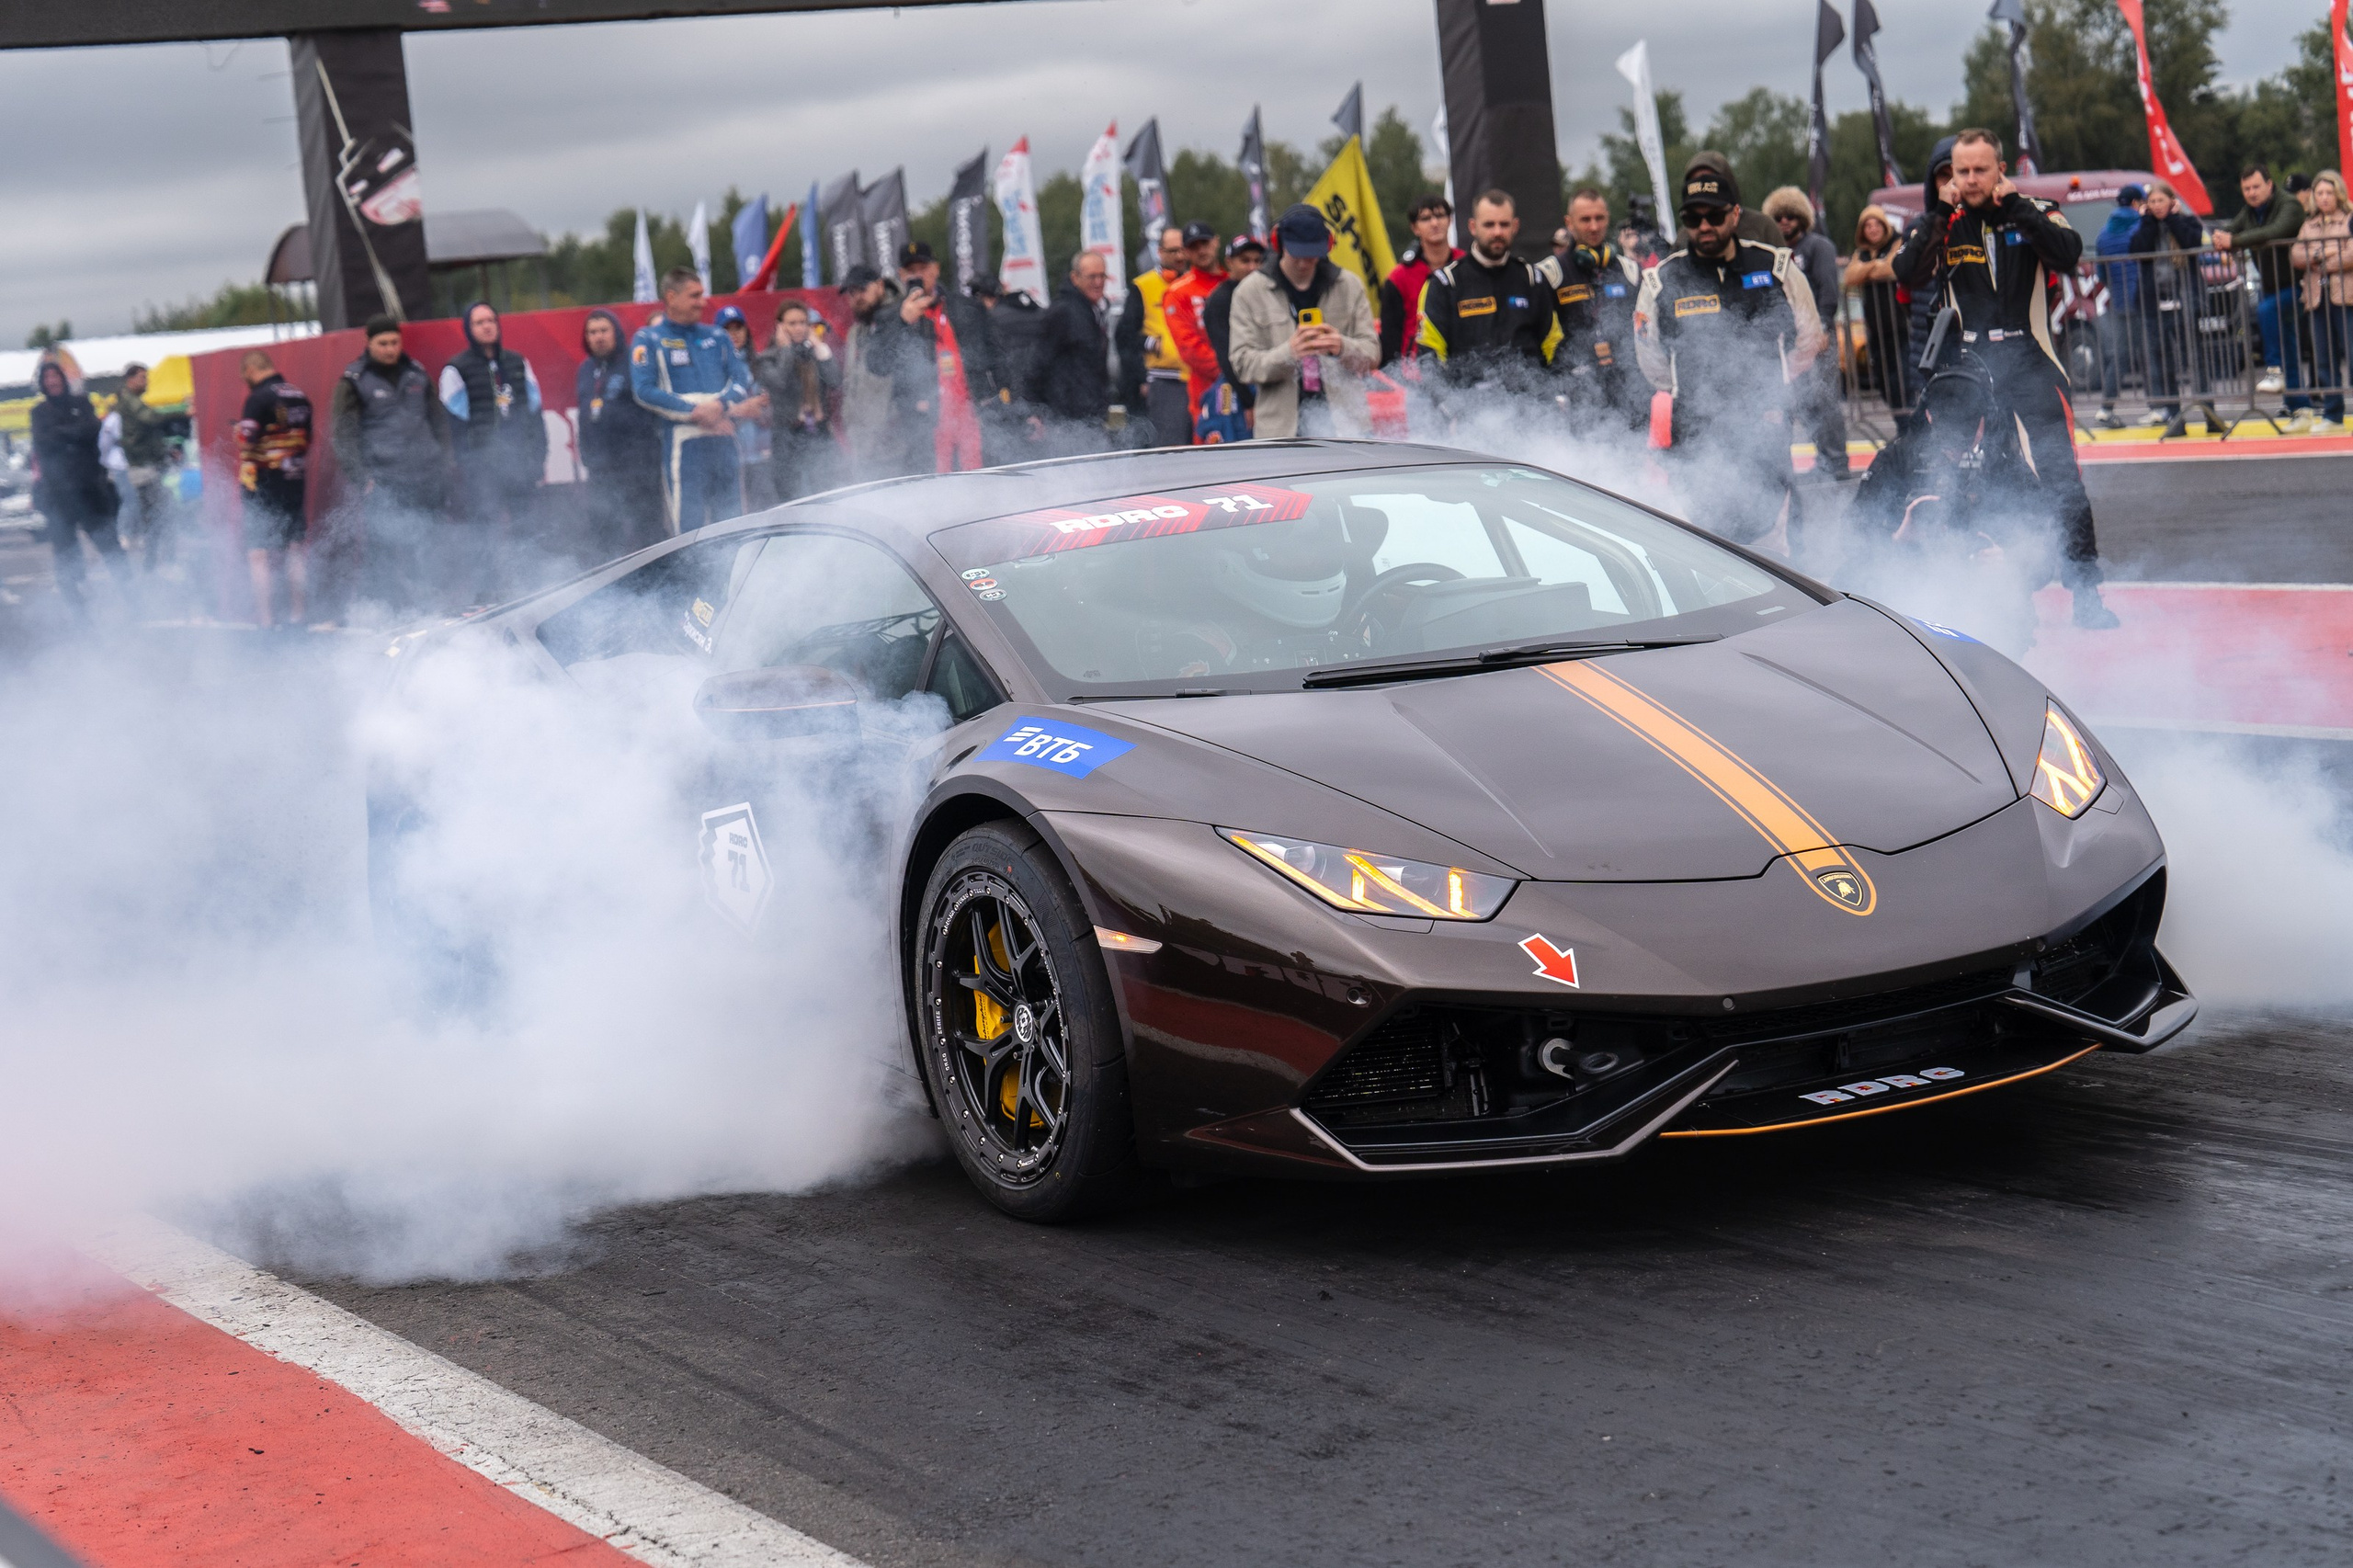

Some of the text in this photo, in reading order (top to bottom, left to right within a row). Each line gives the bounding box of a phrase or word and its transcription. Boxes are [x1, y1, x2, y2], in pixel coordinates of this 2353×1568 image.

[1050, 494, 1274, 534] RDRC 71
[1014, 733, 1094, 764] ВТБ
[727, 849, 751, 893] 71
[1797, 1066, 1965, 1106] RDRC
